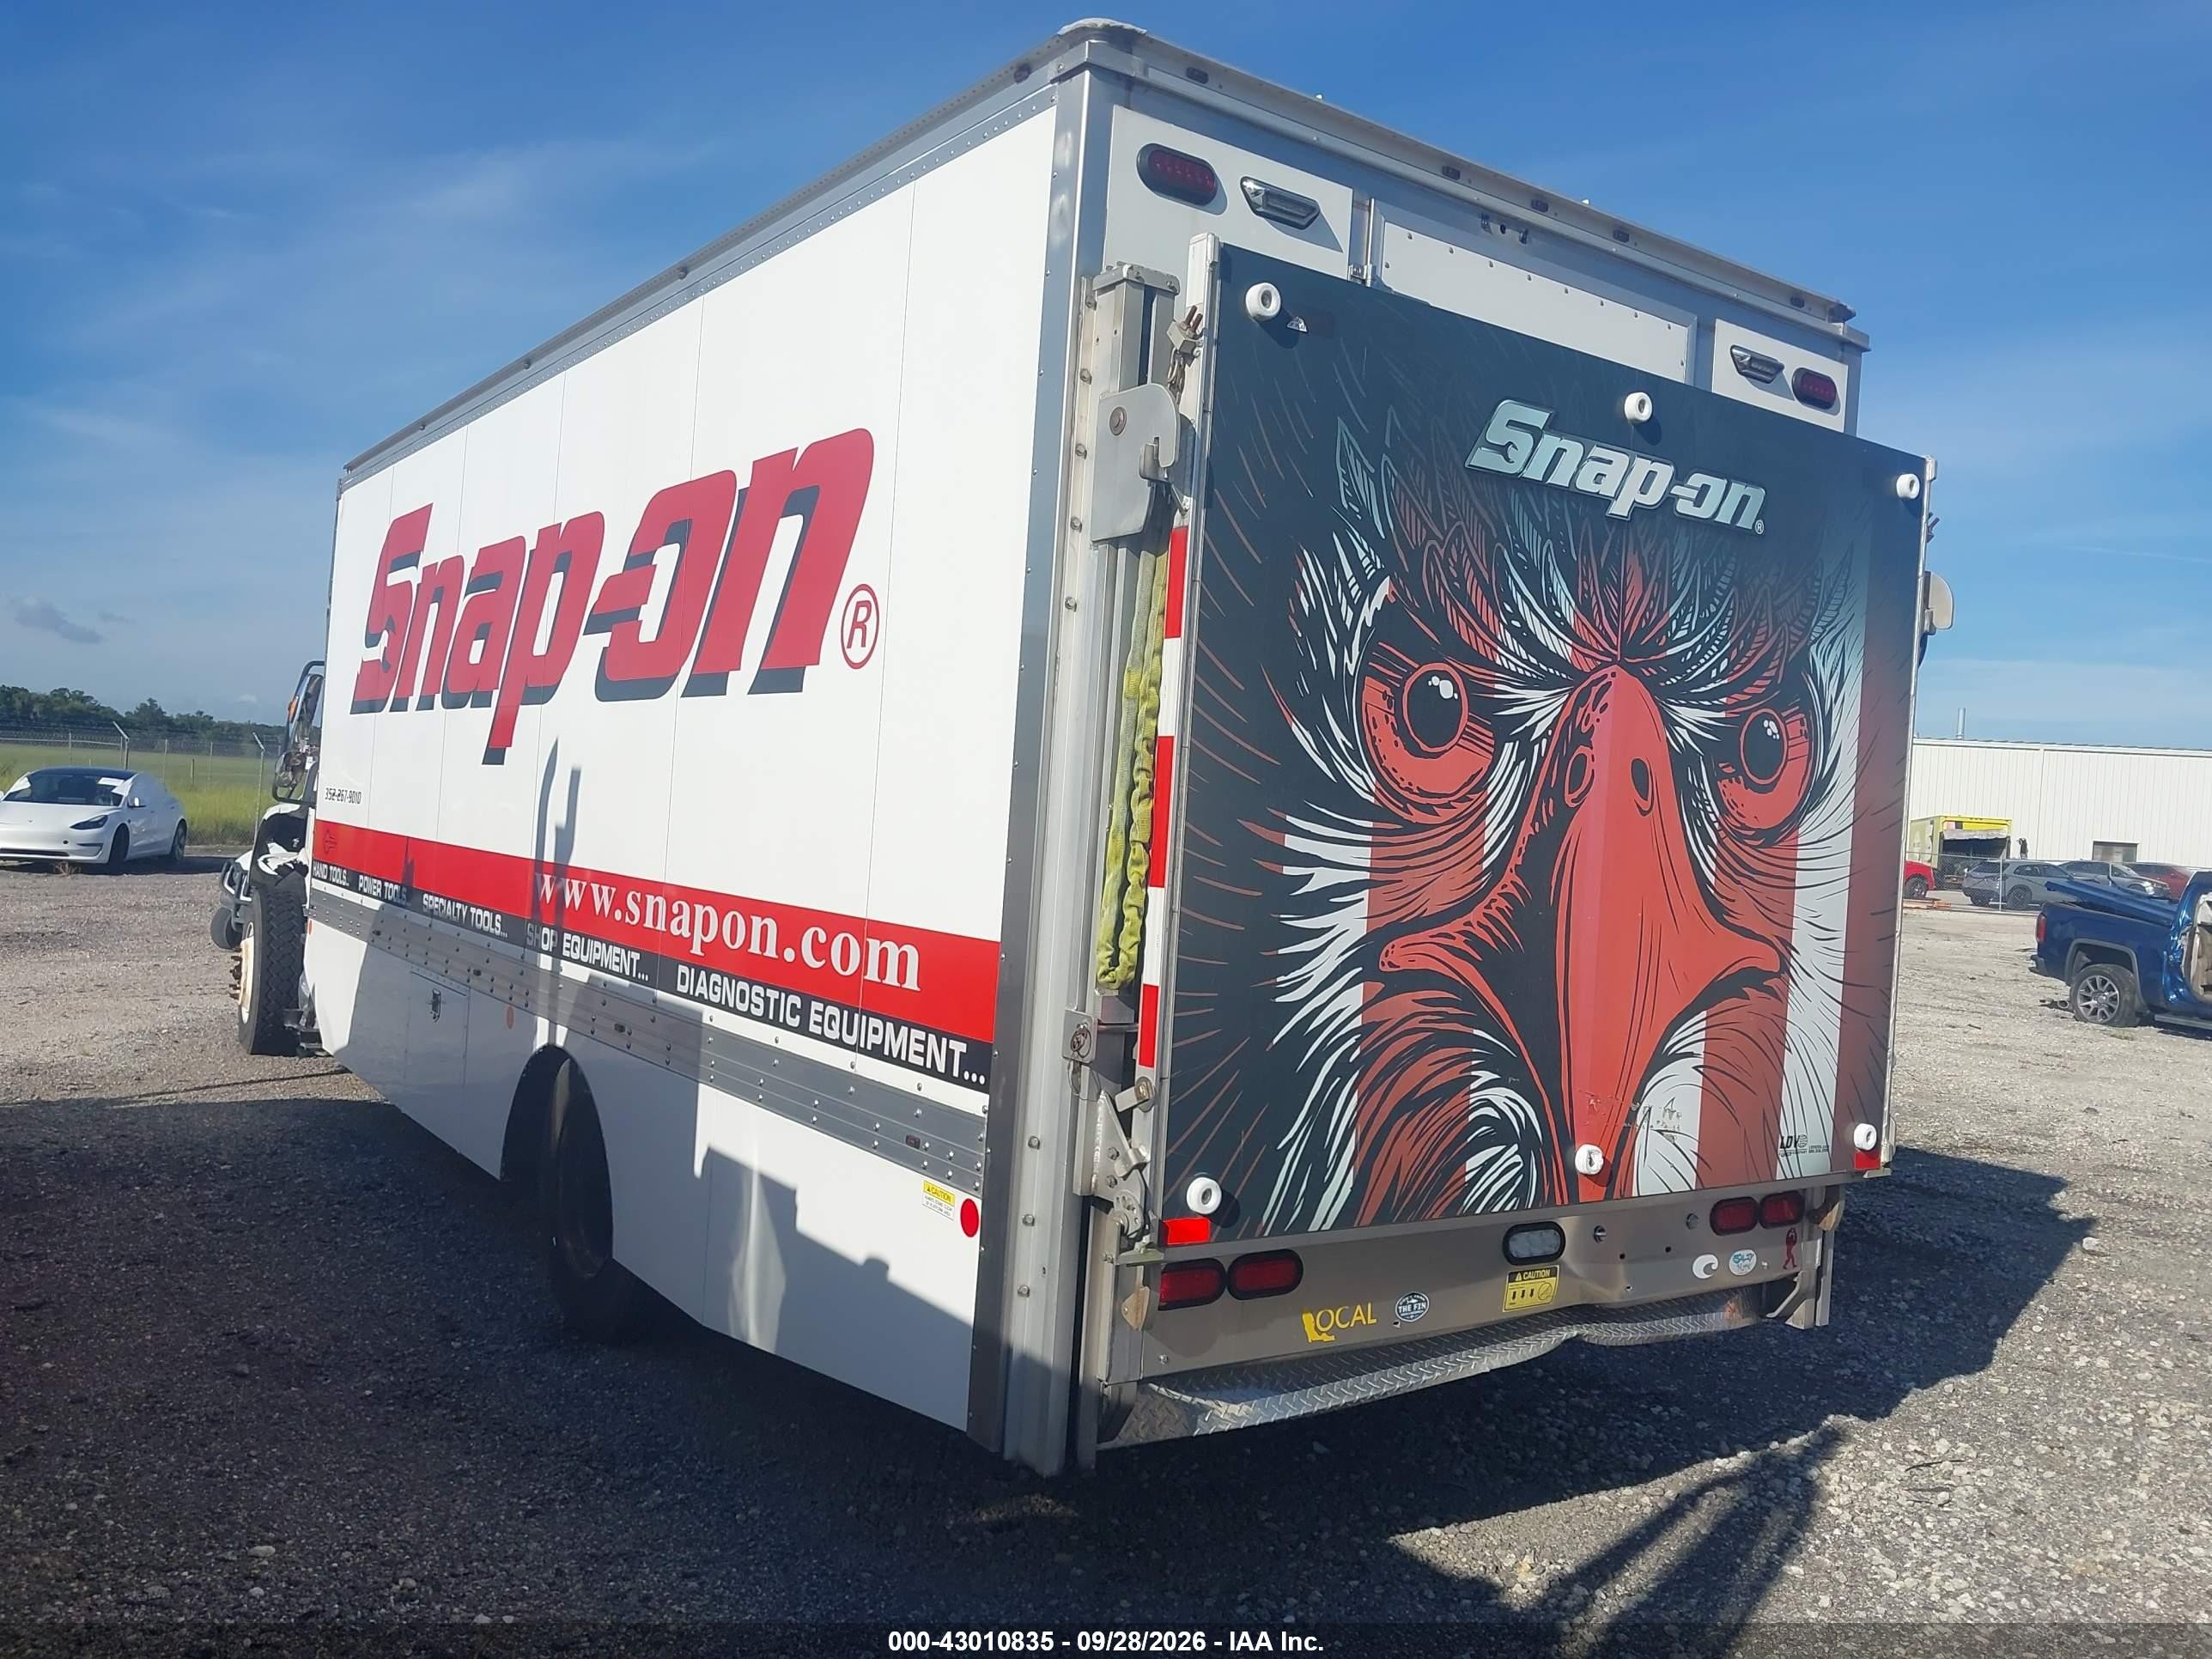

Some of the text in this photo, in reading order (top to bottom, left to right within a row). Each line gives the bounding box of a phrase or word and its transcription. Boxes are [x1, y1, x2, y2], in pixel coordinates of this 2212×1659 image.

[1464, 398, 1766, 531] Snap-on
[349, 428, 874, 765] Snap-on
[325, 787, 362, 805] 352-267-9010
[313, 860, 329, 879] HAND
[358, 874, 382, 899] POWER
[422, 893, 508, 939] SPECIALTY TOOLS...
[535, 872, 921, 993] www.snapon.com
[526, 922, 649, 982] SHOP EQUIPMENT...
[676, 964, 987, 1085] DIAGNOSTIC EQUIPMENT...
[931, 1187, 951, 1203] CAUTION
[1522, 1268, 1551, 1280] CAUTION
[1398, 1304, 1412, 1314] THE
[1413, 1301, 1426, 1311] FIN
